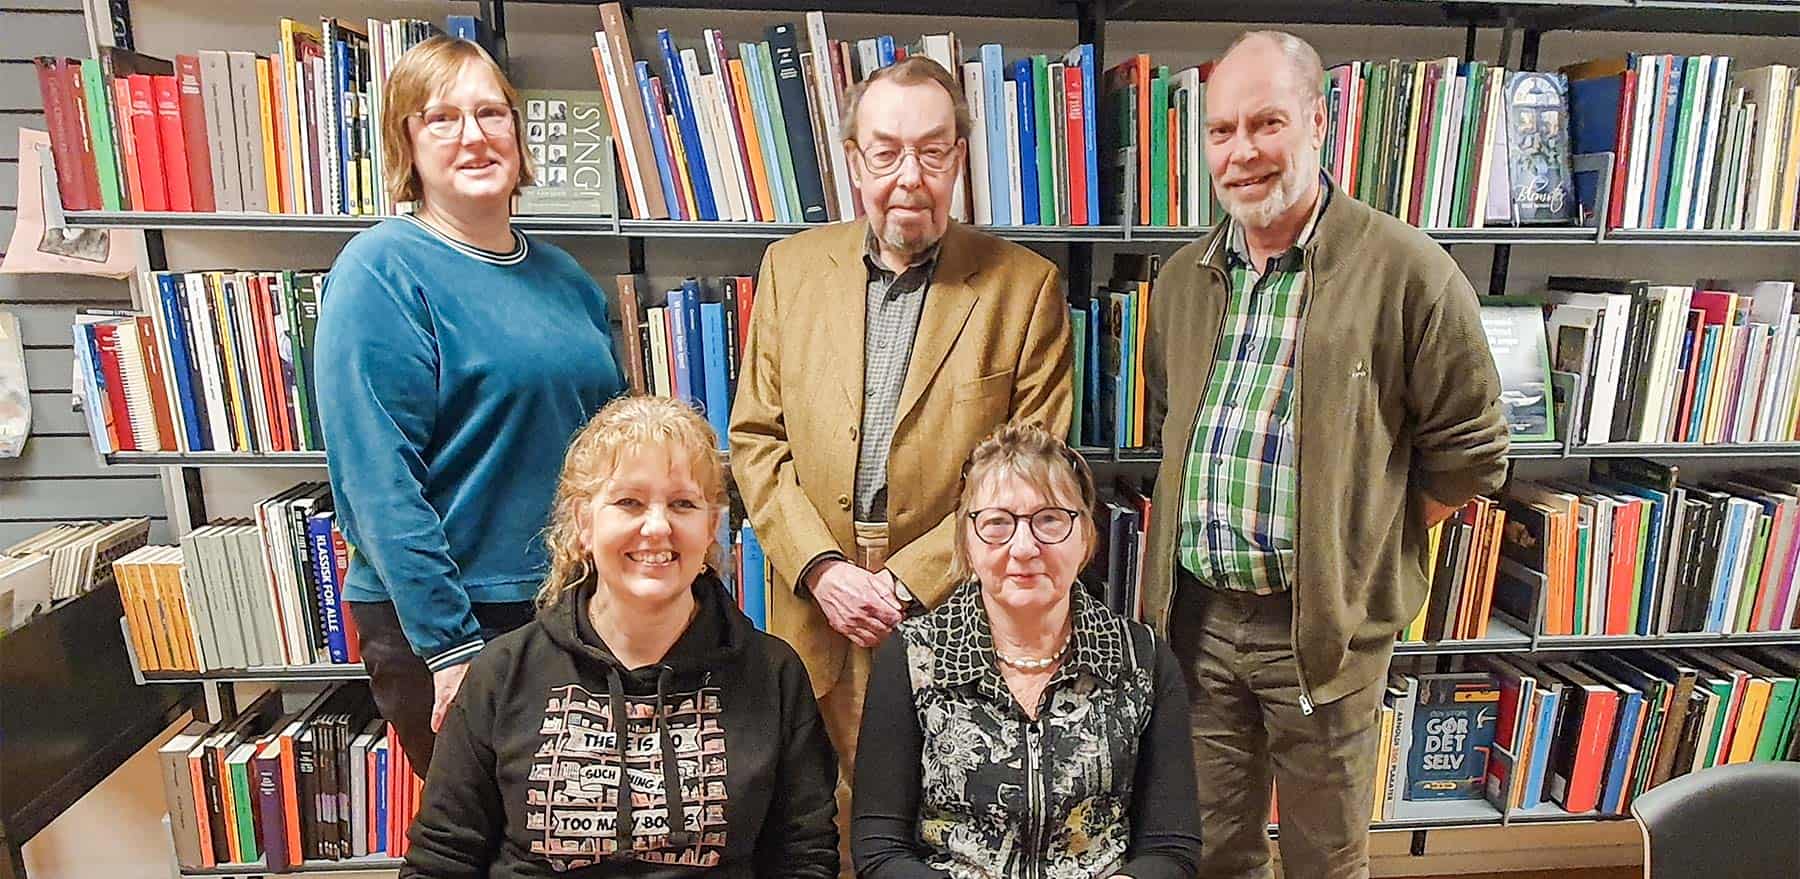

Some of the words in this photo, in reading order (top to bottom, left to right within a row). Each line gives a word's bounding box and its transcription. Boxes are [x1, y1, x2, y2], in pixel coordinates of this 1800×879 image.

[572, 105, 601, 196] SYNG!
[315, 534, 332, 583] KLASSISK
[322, 584, 335, 606] FOR
[326, 607, 339, 632] ALLE
[584, 733, 632, 750] THEE
[638, 737, 654, 751] IS
[1424, 734, 1467, 753] DET
[1422, 753, 1465, 770] SELV
[561, 817, 592, 831] TOO
[597, 815, 640, 831] MAY
[642, 812, 694, 830] BOS
